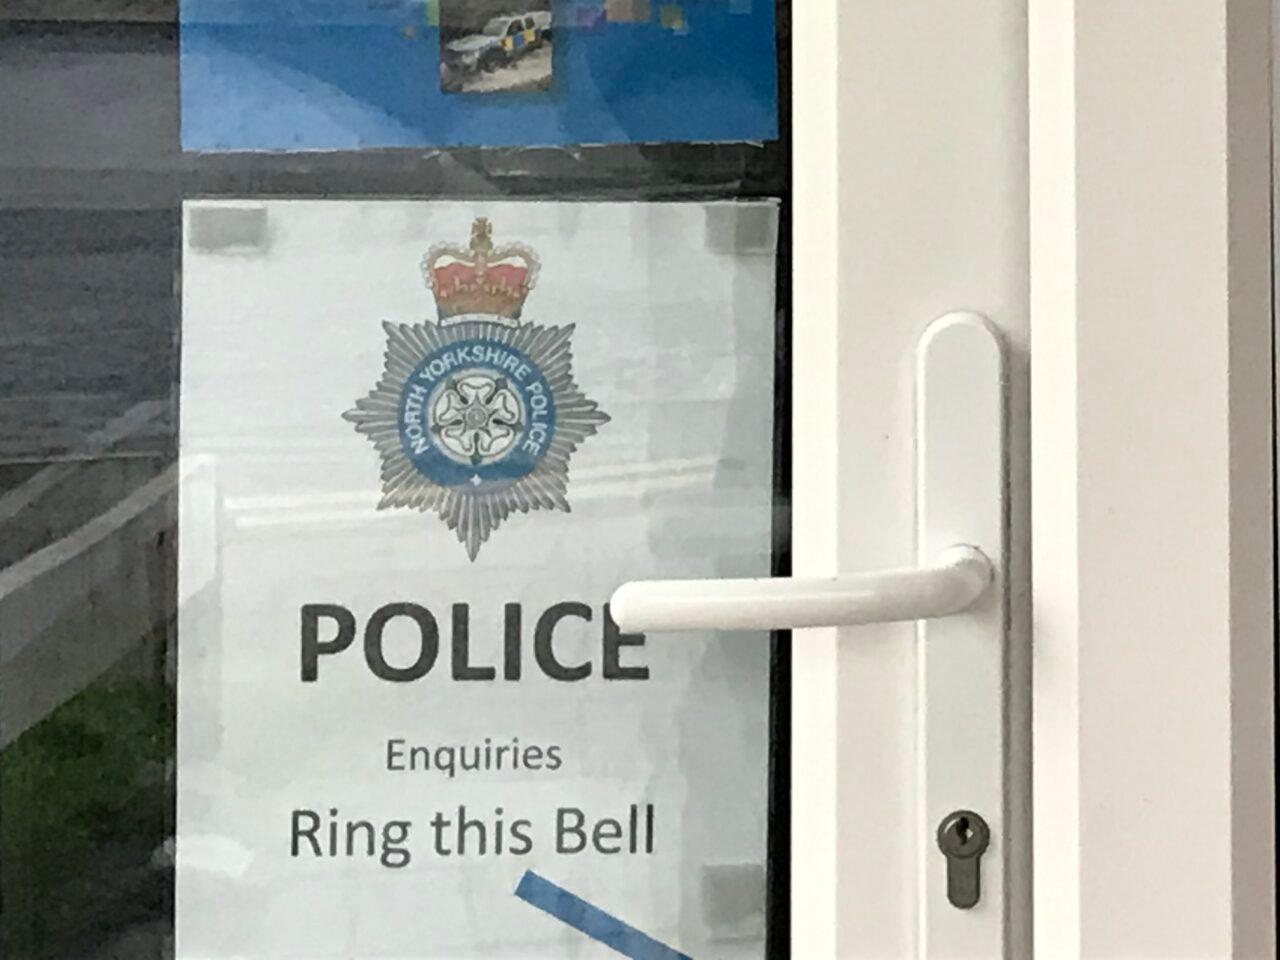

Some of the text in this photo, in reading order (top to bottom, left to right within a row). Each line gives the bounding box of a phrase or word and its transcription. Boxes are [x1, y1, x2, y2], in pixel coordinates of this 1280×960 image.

[404, 345, 547, 455] NORTH YORKSHIRE POLICE
[301, 601, 650, 682] POLICE
[386, 737, 561, 778] Enquiries
[291, 803, 654, 869] Ring this Bell
